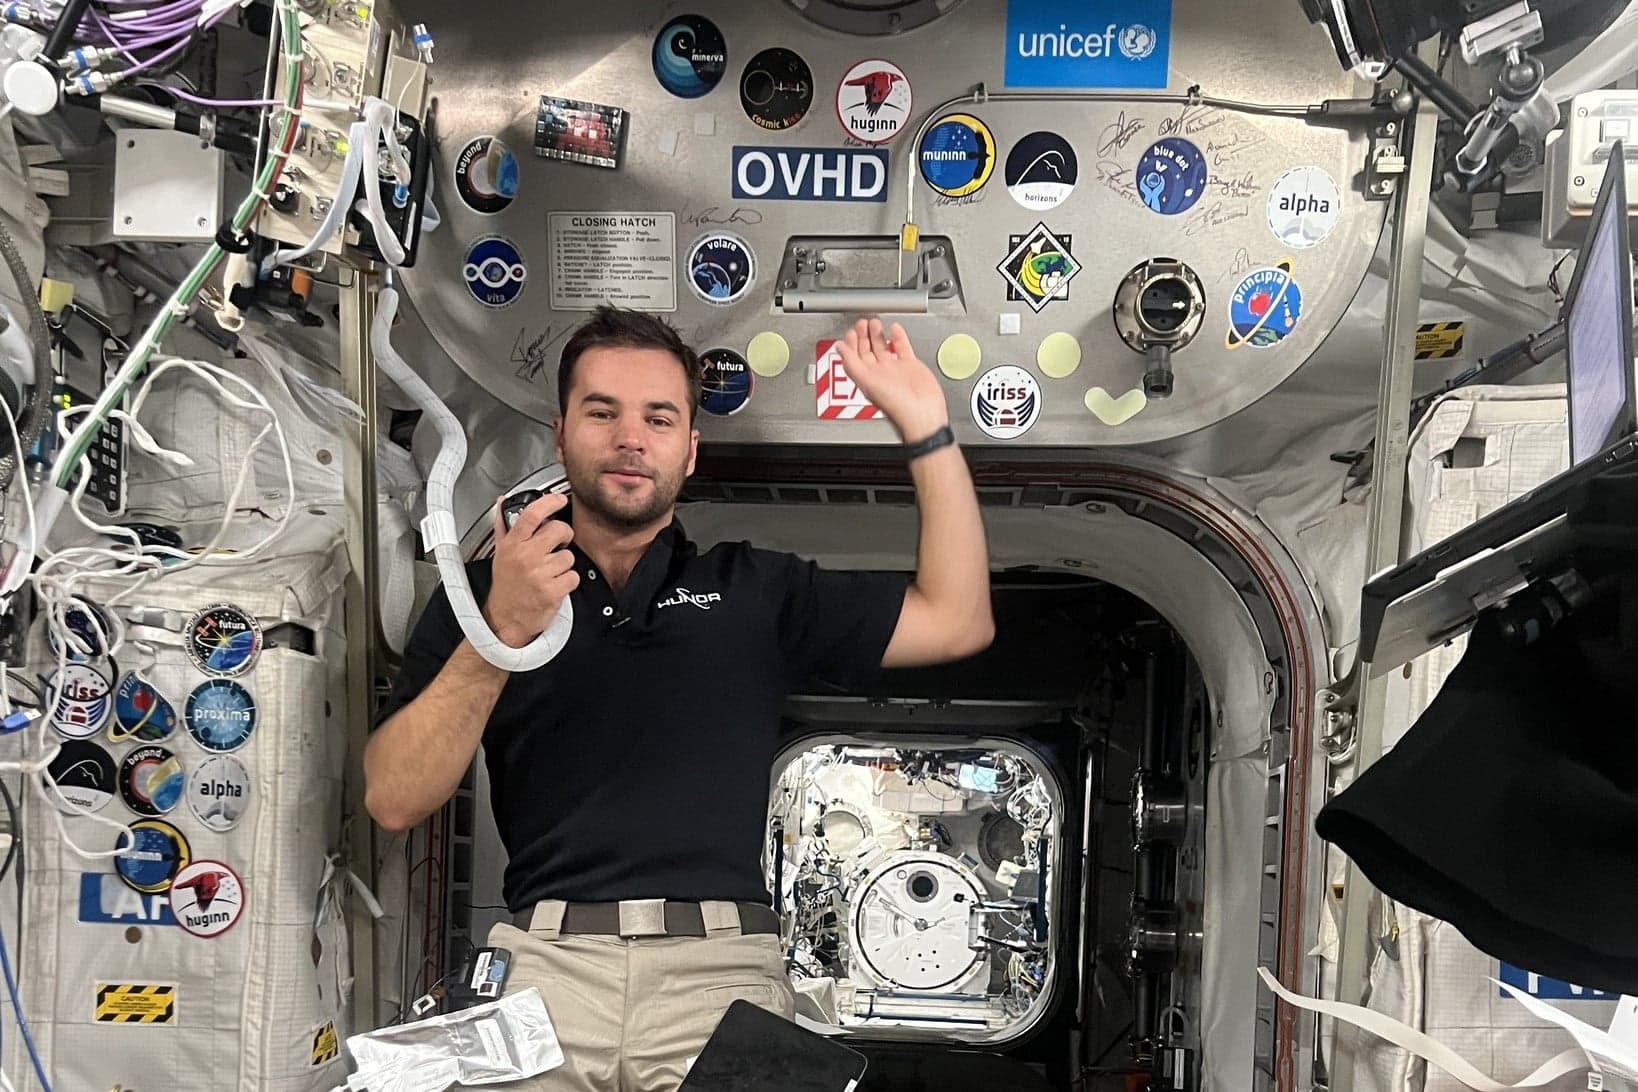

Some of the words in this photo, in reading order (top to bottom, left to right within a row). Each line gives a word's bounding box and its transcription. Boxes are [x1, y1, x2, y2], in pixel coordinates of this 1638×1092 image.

[1018, 24, 1117, 58] unicef
[692, 50, 724, 62] minerva
[751, 113, 781, 129] cosmic
[850, 115, 897, 132] huginn
[457, 140, 482, 175] beyond
[923, 150, 966, 161] muninn
[1153, 145, 1175, 159] blue
[1175, 153, 1190, 172] dot
[737, 151, 886, 197] OVHD
[1024, 192, 1058, 203] horizons
[1279, 193, 1330, 216] alpha
[572, 217, 617, 227] CLOSING
[620, 217, 656, 227] HATCH
[707, 238, 737, 252] volare
[1234, 270, 1286, 304] principia
[486, 292, 506, 303] vita
[716, 360, 744, 372] futura
[986, 382, 1027, 401] iriss
[657, 587, 722, 609] HUNOR
[218, 619, 246, 631] futura
[65, 679, 99, 699] riss
[194, 708, 250, 722] proxima
[127, 748, 162, 766] beyond
[200, 779, 242, 800] alpha
[185, 911, 230, 928] huginn
